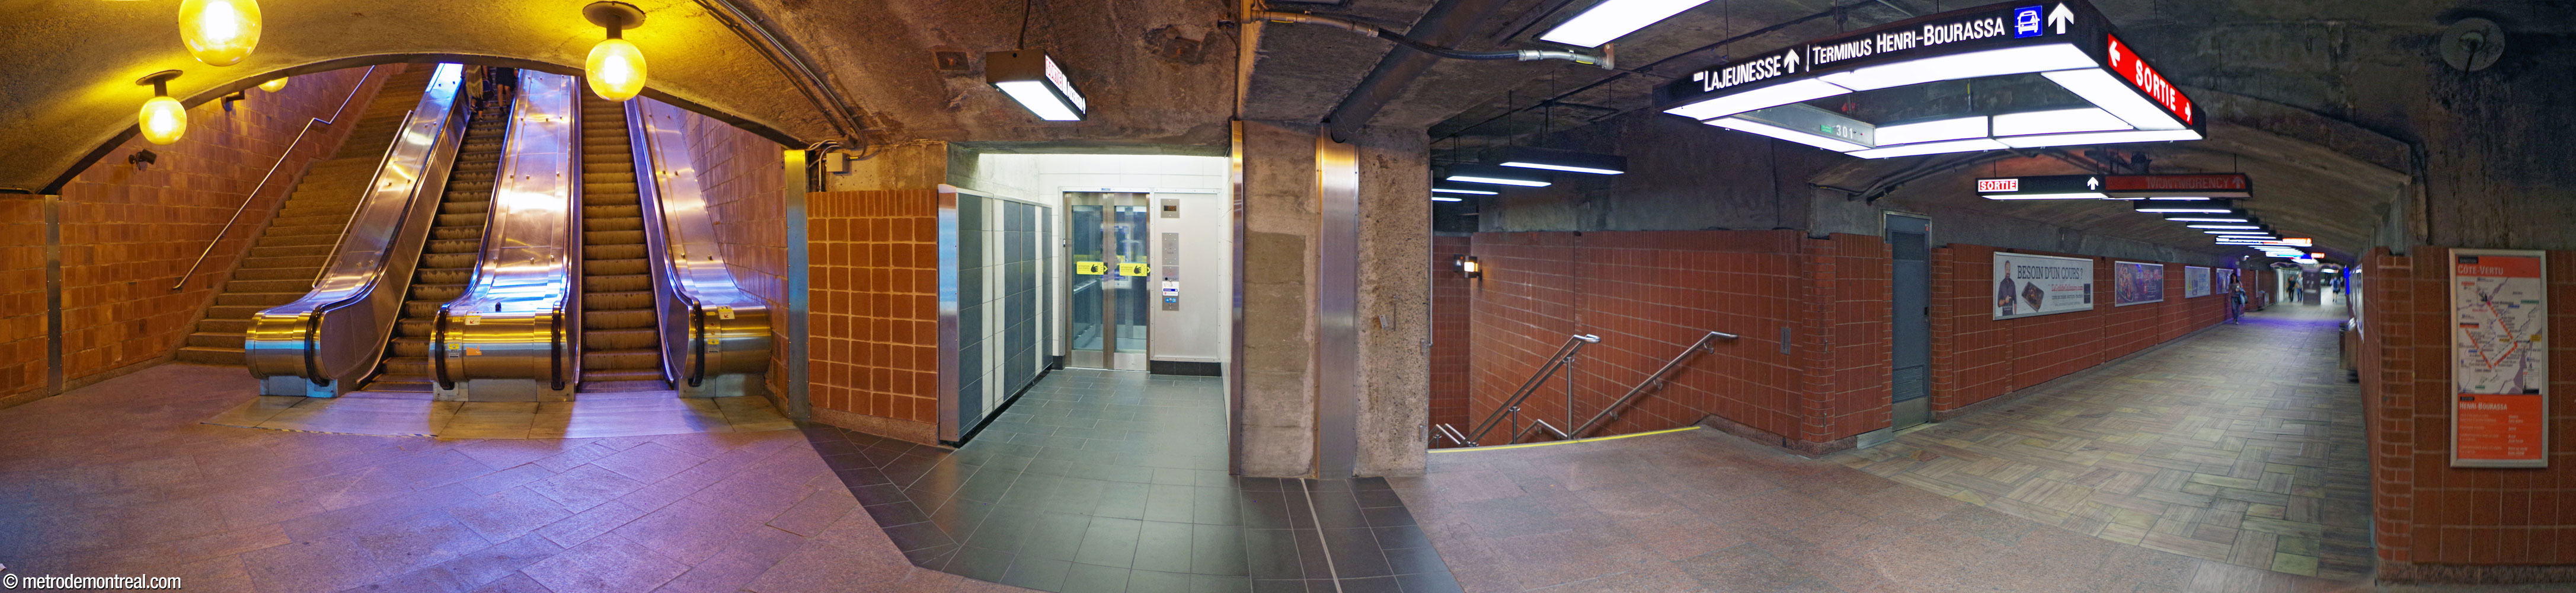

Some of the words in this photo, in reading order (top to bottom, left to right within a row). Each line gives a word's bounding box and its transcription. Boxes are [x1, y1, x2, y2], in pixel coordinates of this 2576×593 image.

[1813, 39, 1872, 65] TERMINUS
[1877, 17, 2005, 53] HENRI-BOURASSA
[1046, 59, 1062, 89] SORTIE
[1704, 55, 1781, 92] LAJEUNESSE
[2136, 59, 2176, 111] SORTIE
[1836, 125, 1853, 139] 301
[1980, 181, 2016, 190] SORTIE
[2146, 176, 2229, 189] MONTMORENCY
[2018, 265, 2043, 279] BESOIN
[2061, 267, 2079, 279] COURS
